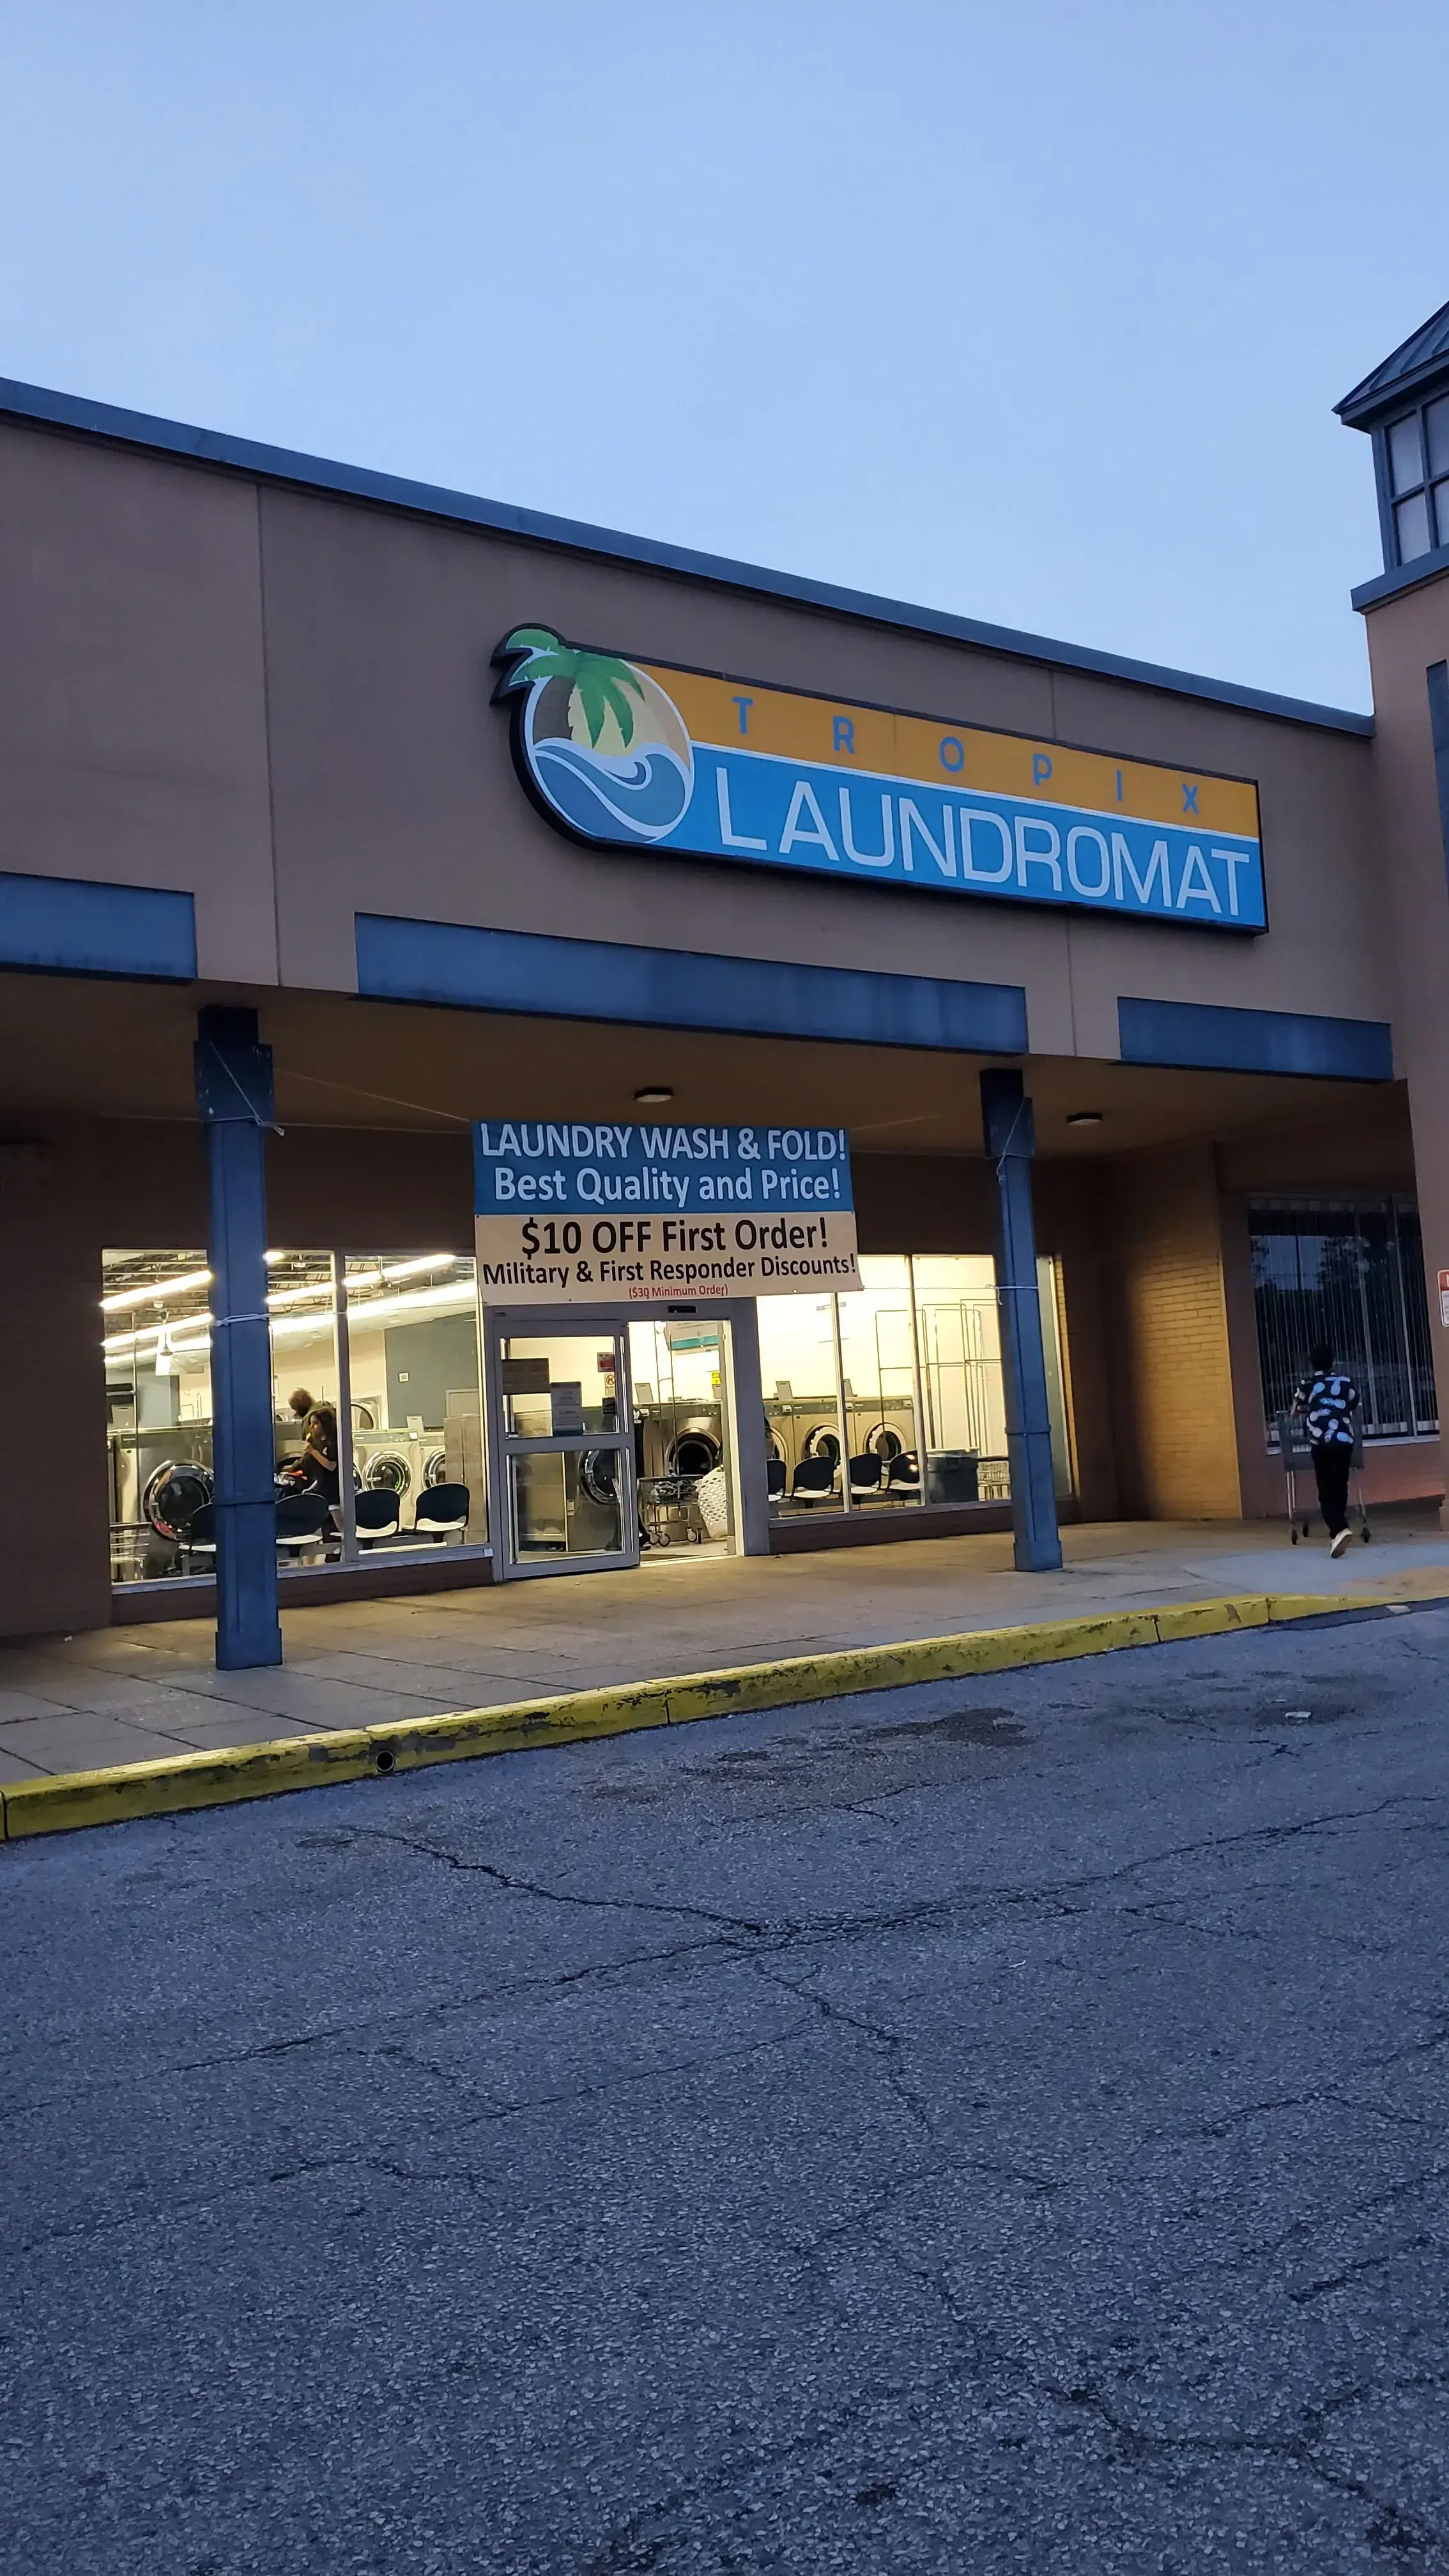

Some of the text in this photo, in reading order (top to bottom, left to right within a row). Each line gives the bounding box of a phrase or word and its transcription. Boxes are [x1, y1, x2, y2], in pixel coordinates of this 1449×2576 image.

[732, 695, 1200, 815] TROPIX
[716, 767, 1250, 917] LAUNDROMAT
[480, 1123, 846, 1160] LAUNDRY WASH & FOLD!
[494, 1166, 840, 1208] Best Quality and Price!
[521, 1216, 827, 1261] $10 OFF First Order!
[483, 1253, 856, 1288] Military & First Responder Discounts!
[629, 1284, 728, 1300] ($30 Minimum Order)
